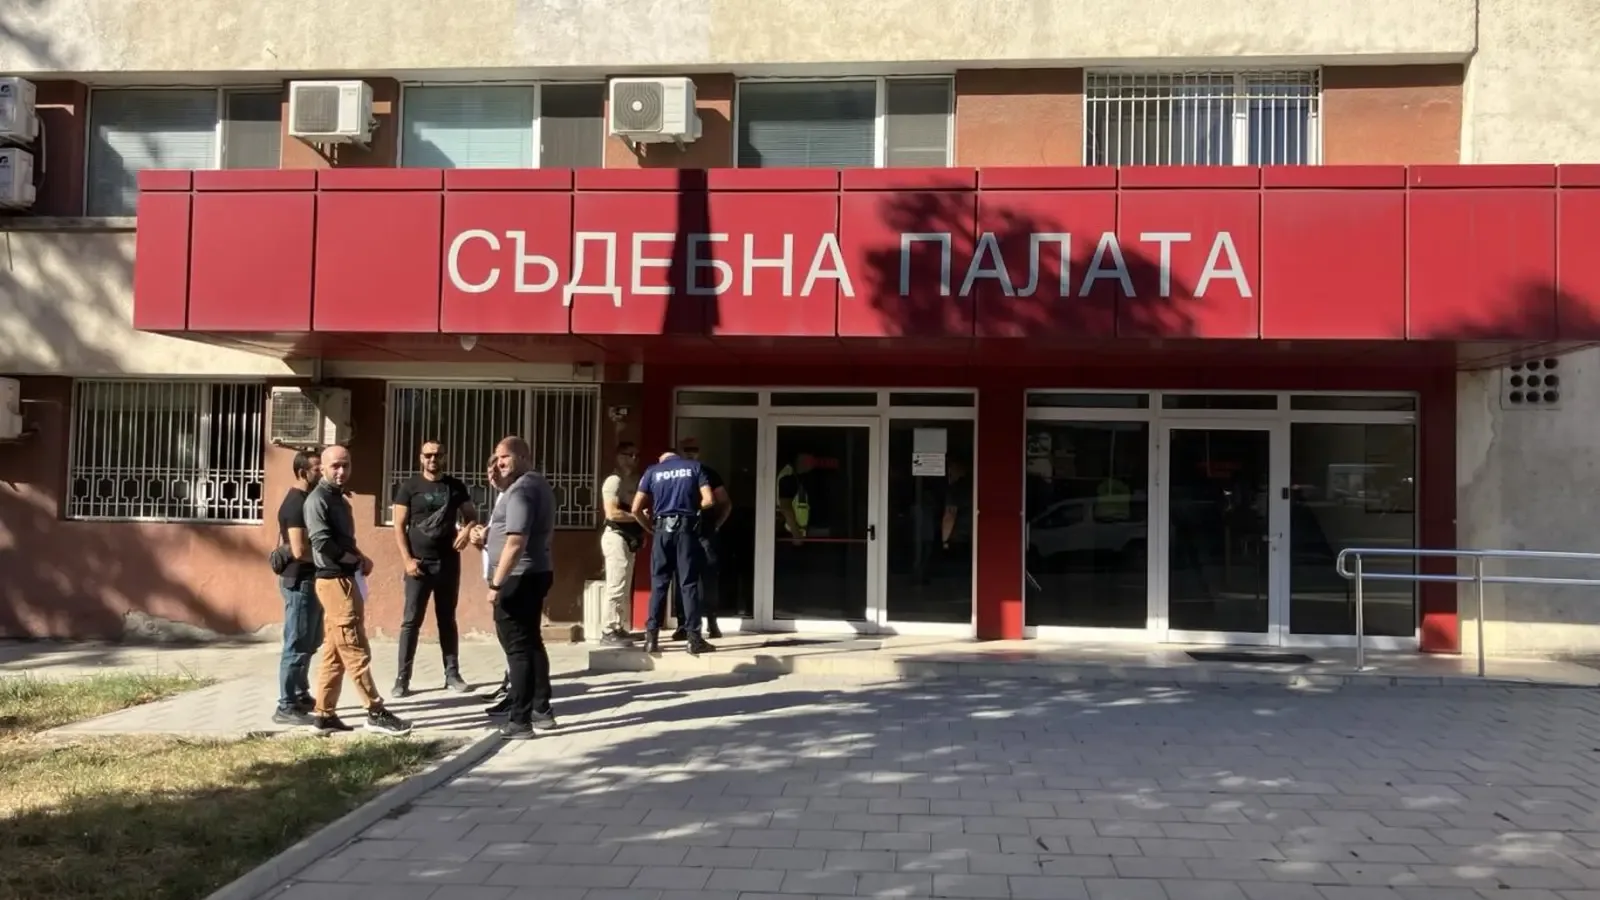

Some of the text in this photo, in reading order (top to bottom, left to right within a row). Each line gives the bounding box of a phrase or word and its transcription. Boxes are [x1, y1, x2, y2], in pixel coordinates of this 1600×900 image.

[447, 230, 1253, 307] СЪДЕБНА ПАЛАТА
[656, 469, 692, 481] POLICE
